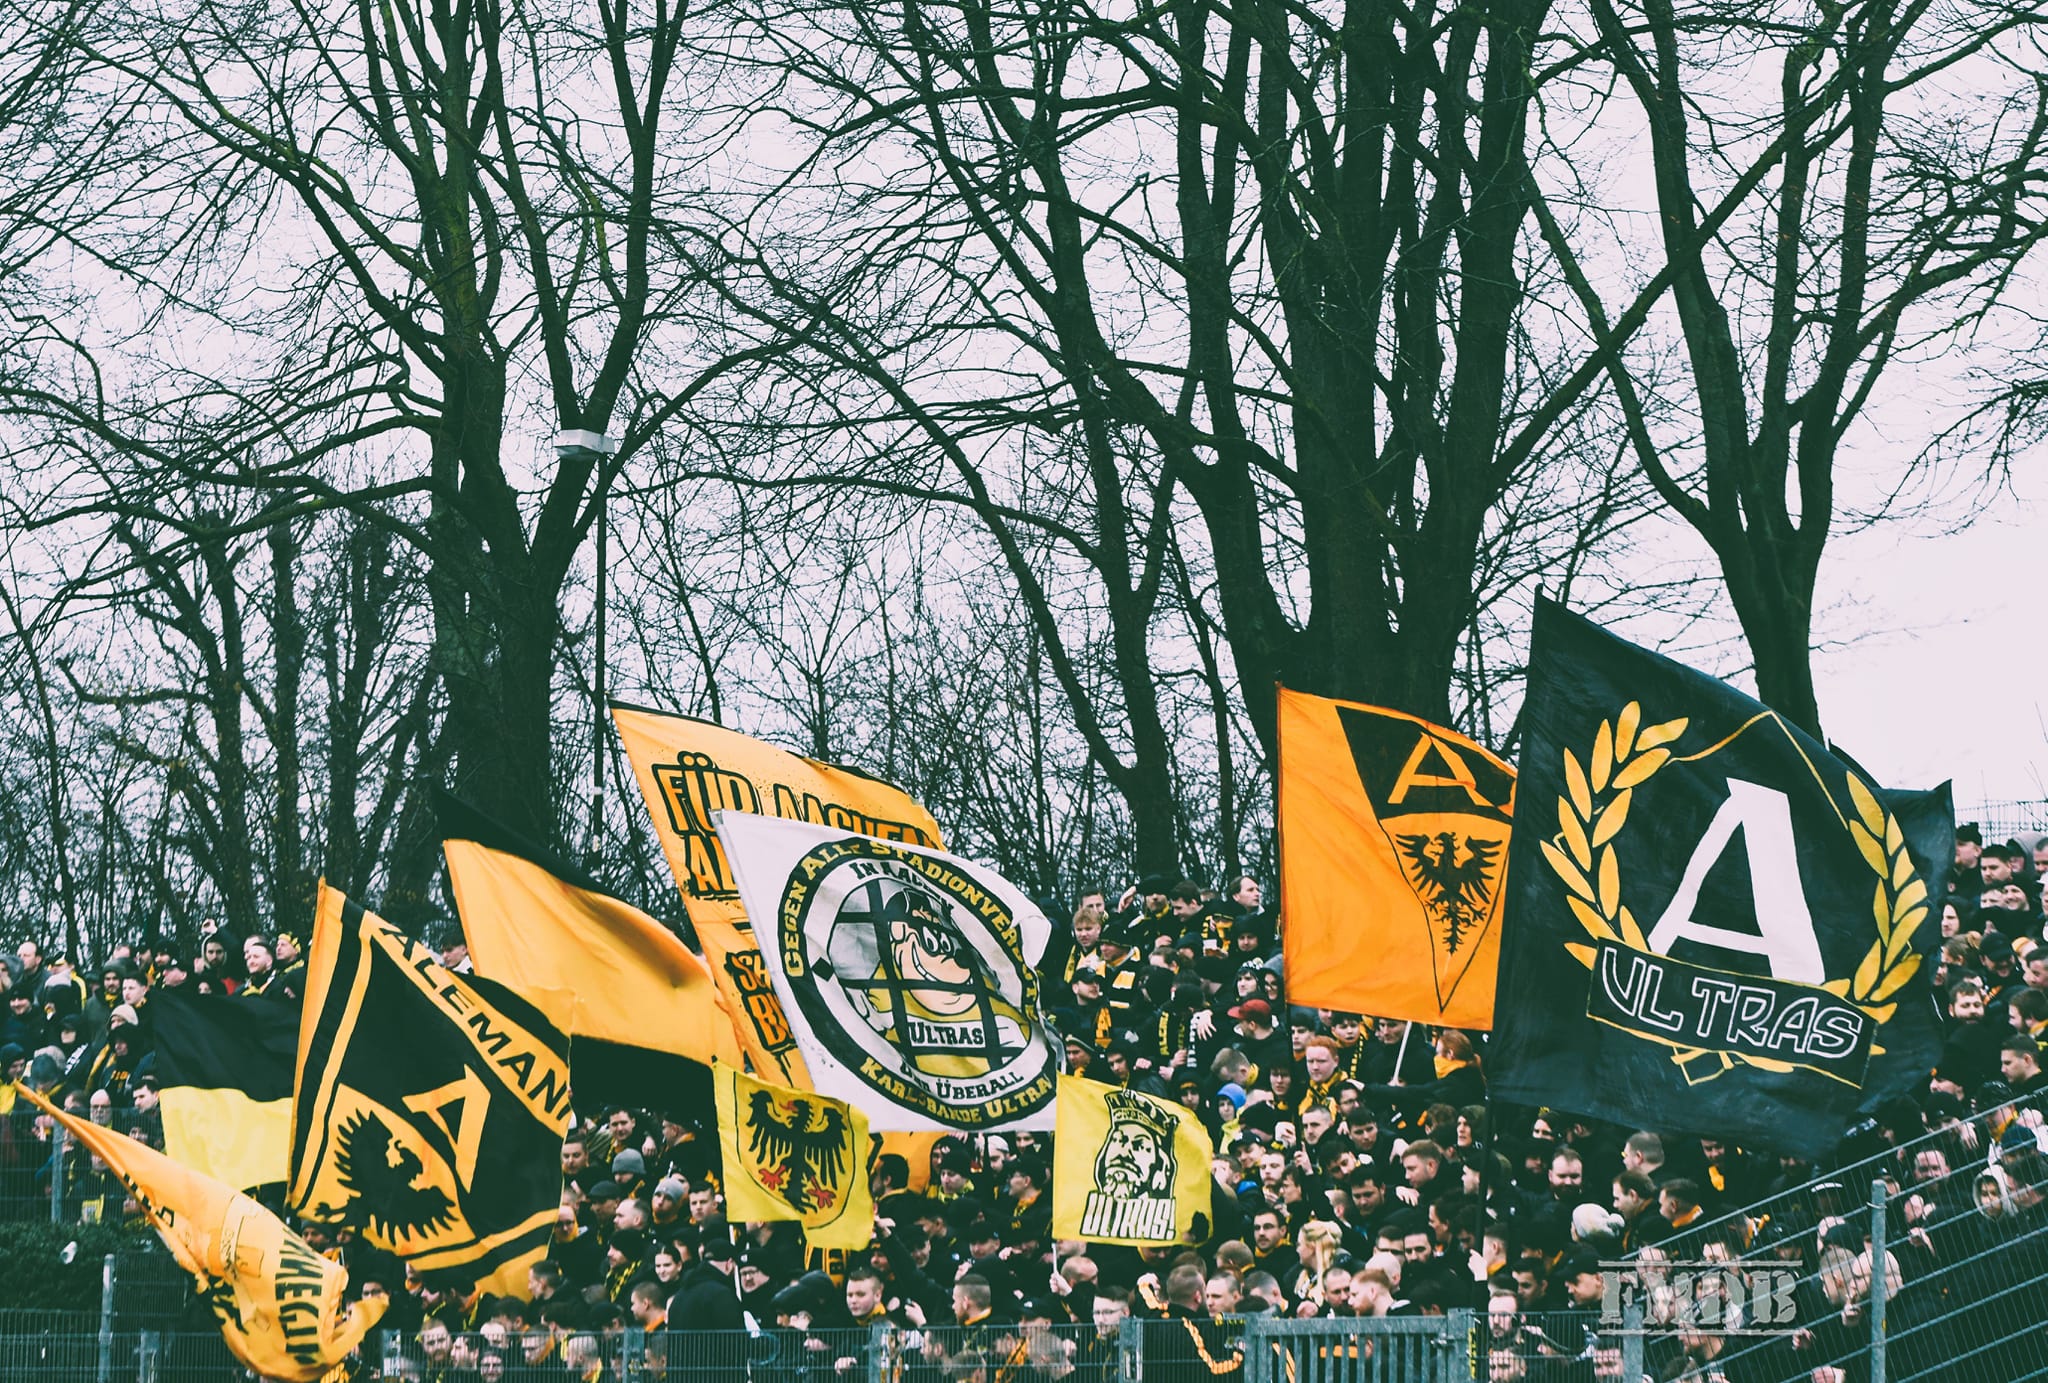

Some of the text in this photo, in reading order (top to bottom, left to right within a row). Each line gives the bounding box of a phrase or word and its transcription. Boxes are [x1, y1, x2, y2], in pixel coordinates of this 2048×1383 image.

[849, 862, 879, 880] IN
[1649, 778, 1826, 985] A
[784, 880, 807, 977] GEGEN
[1602, 947, 1863, 1059] ULTRAS
[908, 1022, 985, 1045] ULTRAS
[936, 1071, 1024, 1100] ÜBERALL
[1080, 1191, 1176, 1241] ULTRAS!
